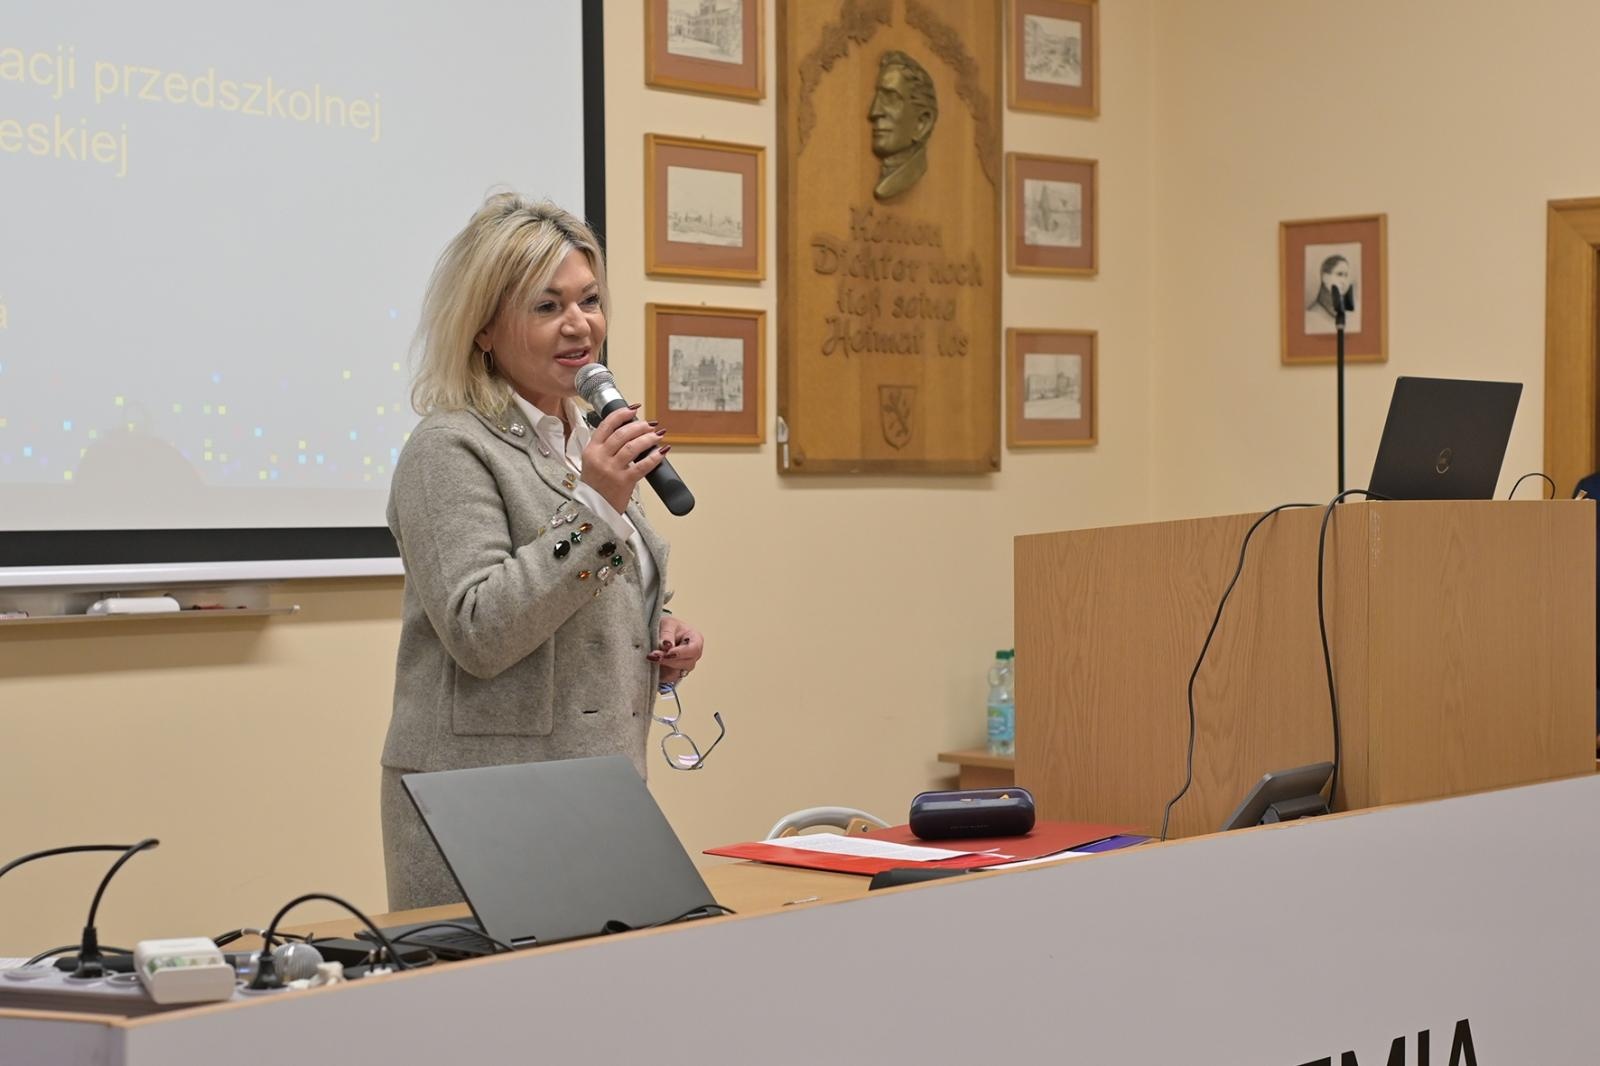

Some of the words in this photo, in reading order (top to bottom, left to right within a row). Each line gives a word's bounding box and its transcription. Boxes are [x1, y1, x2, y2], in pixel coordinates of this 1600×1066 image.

[94, 60, 383, 143] przedszkolnej
[0, 113, 129, 178] eskiej
[821, 315, 925, 359] Heimat
